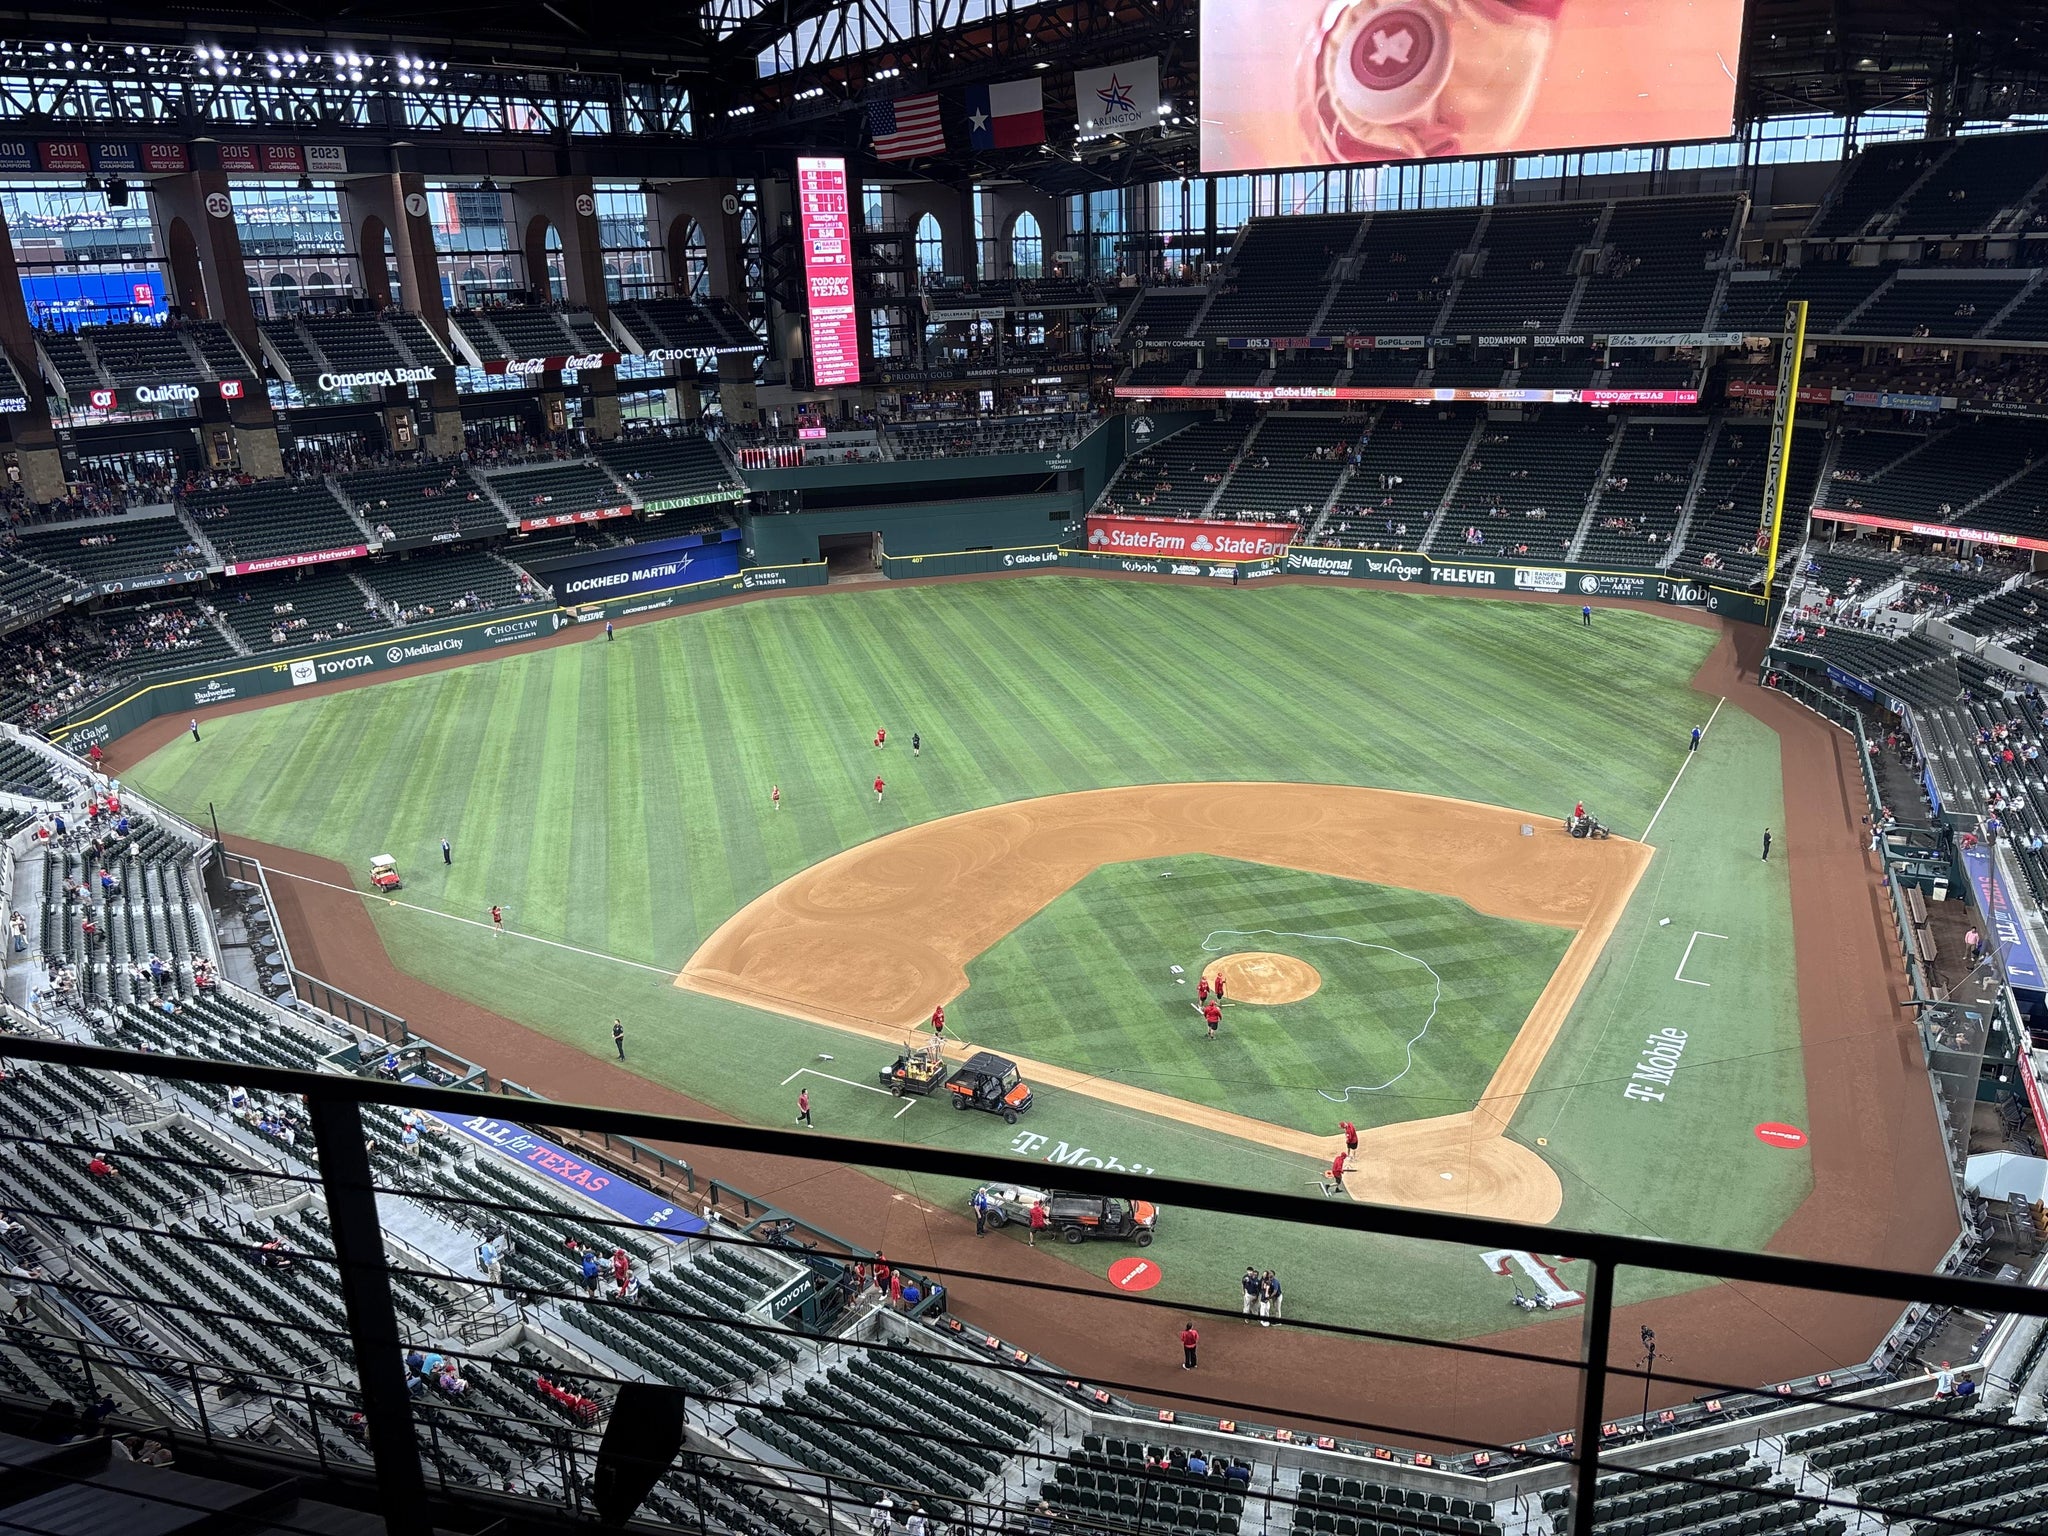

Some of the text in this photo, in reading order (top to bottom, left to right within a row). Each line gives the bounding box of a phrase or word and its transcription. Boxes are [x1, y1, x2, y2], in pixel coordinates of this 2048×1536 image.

[1093, 111, 1143, 126] ARLINGTON
[50, 144, 78, 157] 2011
[101, 144, 128, 157] 2011
[151, 145, 180, 157] 2012
[222, 146, 250, 158] 2015
[269, 146, 296, 158] 2016
[311, 147, 339, 159] 2023
[208, 198, 229, 213] 26
[412, 199, 421, 212] 7
[578, 198, 593, 213] 29
[725, 198, 736, 211] 10
[810, 277, 835, 287] TODO
[811, 285, 849, 297] TEJAS
[1145, 339, 1205, 348] PRIORITY COMMERCE
[1246, 338, 1270, 348] 105.3
[1353, 338, 1372, 346] PGL
[1377, 338, 1422, 347] GoPGL.com
[1433, 337, 1453, 346] PGL
[1478, 336, 1527, 345] BODYARMOR
[1534, 335, 1584, 344] BODYARMOR
[1610, 335, 1638, 347] Blue
[1640, 334, 1673, 345] Mint
[655, 346, 716, 362] CHOCTAW
[506, 359, 545, 375] Coca-Cola
[565, 353, 604, 370] Coca-Cola
[1047, 363, 1091, 372] PLUCKERS
[397, 366, 437, 383] Bank
[892, 370, 953, 381] PRIORITY GOLD
[967, 367, 1034, 377] HARGROVE ROOFING
[1776, 336, 1793, 423] CHIKIN
[136, 385, 199, 402] QuikTrip
[221, 382, 239, 396] QT
[1274, 387, 1300, 397] Globe
[1300, 387, 1316, 397] Life
[1317, 388, 1336, 397] Field
[1595, 391, 1618, 399] TODO
[1633, 391, 1663, 399] TEJAS
[92, 392, 112, 406] QT
[655, 490, 741, 512] LUXOR STAFFING
[1764, 466, 1777, 524] FARE
[580, 511, 597, 519] DEX
[604, 507, 621, 516] DEX
[530, 518, 549, 526] DEX
[432, 531, 461, 542] ARENA
[1959, 528, 1982, 540] Globe
[1983, 531, 1999, 542] Life
[1999, 534, 2017, 545] Field
[248, 548, 357, 572] America's Best Network
[1015, 552, 1058, 564] Globe Life
[1302, 556, 1352, 570] National
[1122, 560, 1158, 573] Kubota
[1383, 558, 1423, 581] Kroger
[566, 564, 676, 593] LOCKHEED MARTIN
[755, 572, 779, 580] ENERGY
[132, 578, 165, 589] American
[1611, 583, 1631, 591] A&M
[623, 602, 667, 614] LOCKHEED MARTIN
[490, 620, 538, 637] CHOCTAW
[404, 638, 463, 658] Medical City
[272, 655, 373, 675] 372 TOYOTA
[194, 687, 236, 700] Budweiser
[1996, 922, 2021, 945] ALL
[1632, 1027, 1688, 1085] Mobile
[462, 1116, 609, 1192] ALL for TEXAS
[774, 1278, 812, 1311] TOYOTA
